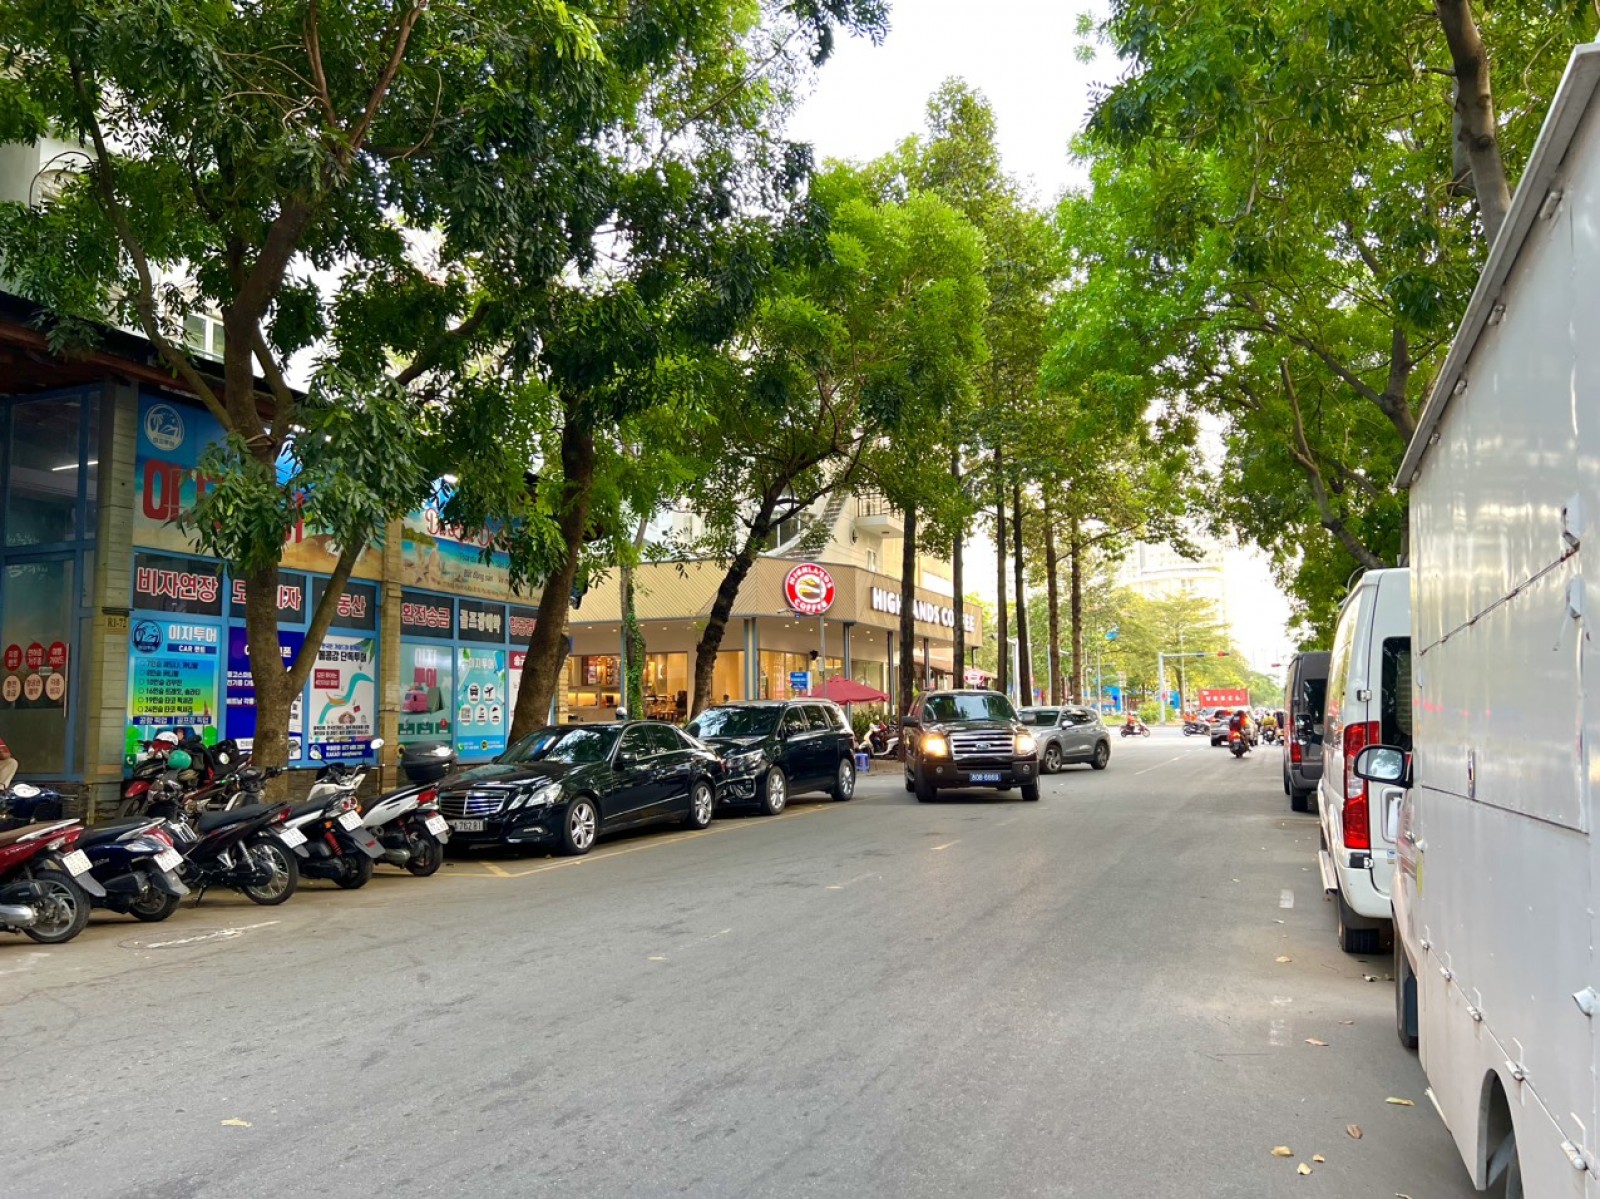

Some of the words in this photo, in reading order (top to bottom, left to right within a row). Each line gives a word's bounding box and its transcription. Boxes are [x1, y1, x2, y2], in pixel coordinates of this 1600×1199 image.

[137, 567, 218, 603] 비자연장
[336, 593, 366, 617] 동산
[402, 603, 450, 629] 환전송금
[873, 586, 940, 624] HIGHANDS
[941, 606, 976, 632] COEE
[168, 624, 217, 643] 이지투어
